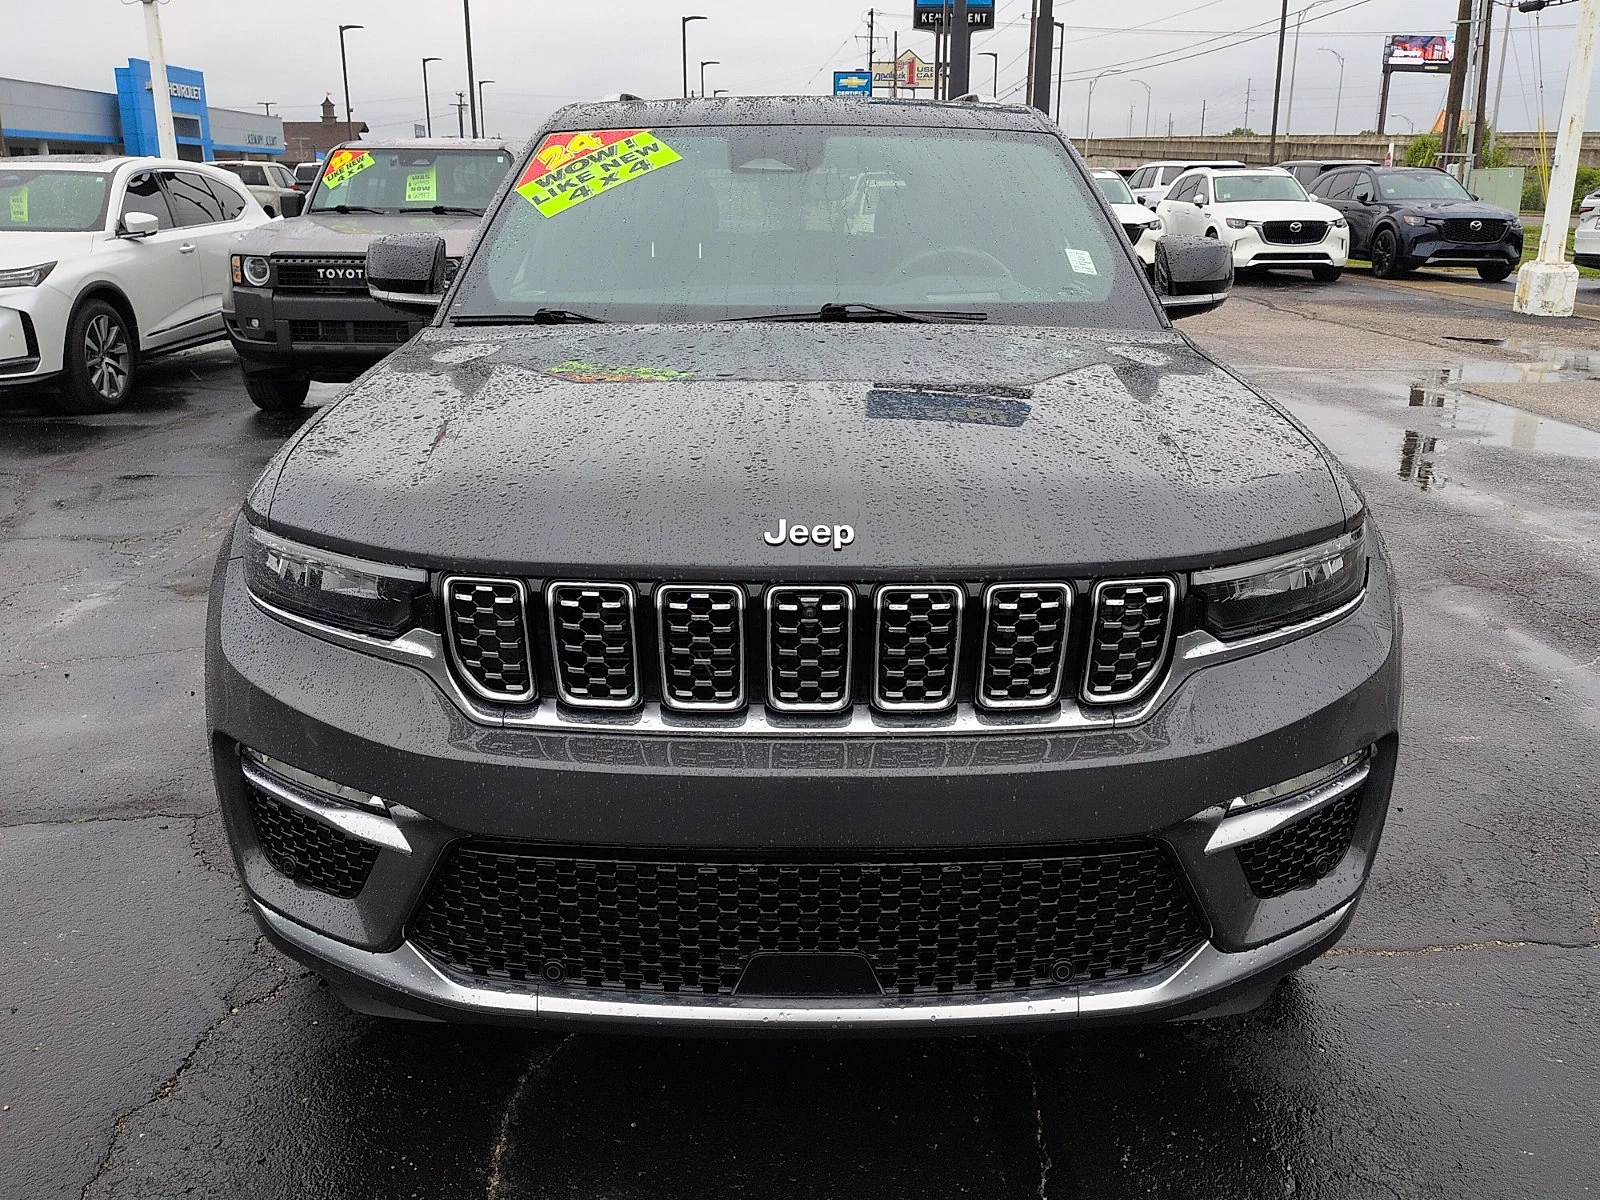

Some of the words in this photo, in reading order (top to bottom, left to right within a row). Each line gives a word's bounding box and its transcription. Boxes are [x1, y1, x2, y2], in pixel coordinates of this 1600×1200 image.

[921, 13, 953, 23] KEN
[967, 13, 987, 23] ENT
[168, 82, 201, 101] HEVROLET
[327, 168, 344, 181] LIKE
[346, 156, 365, 169] NEW
[535, 145, 617, 188] WOW
[537, 133, 604, 171] 24
[532, 170, 595, 205] LIKE
[600, 142, 660, 172] NEW
[569, 185, 594, 201] 4
[629, 159, 654, 174] 4
[317, 268, 365, 279] TOYOT
[763, 518, 855, 551] Jeep
